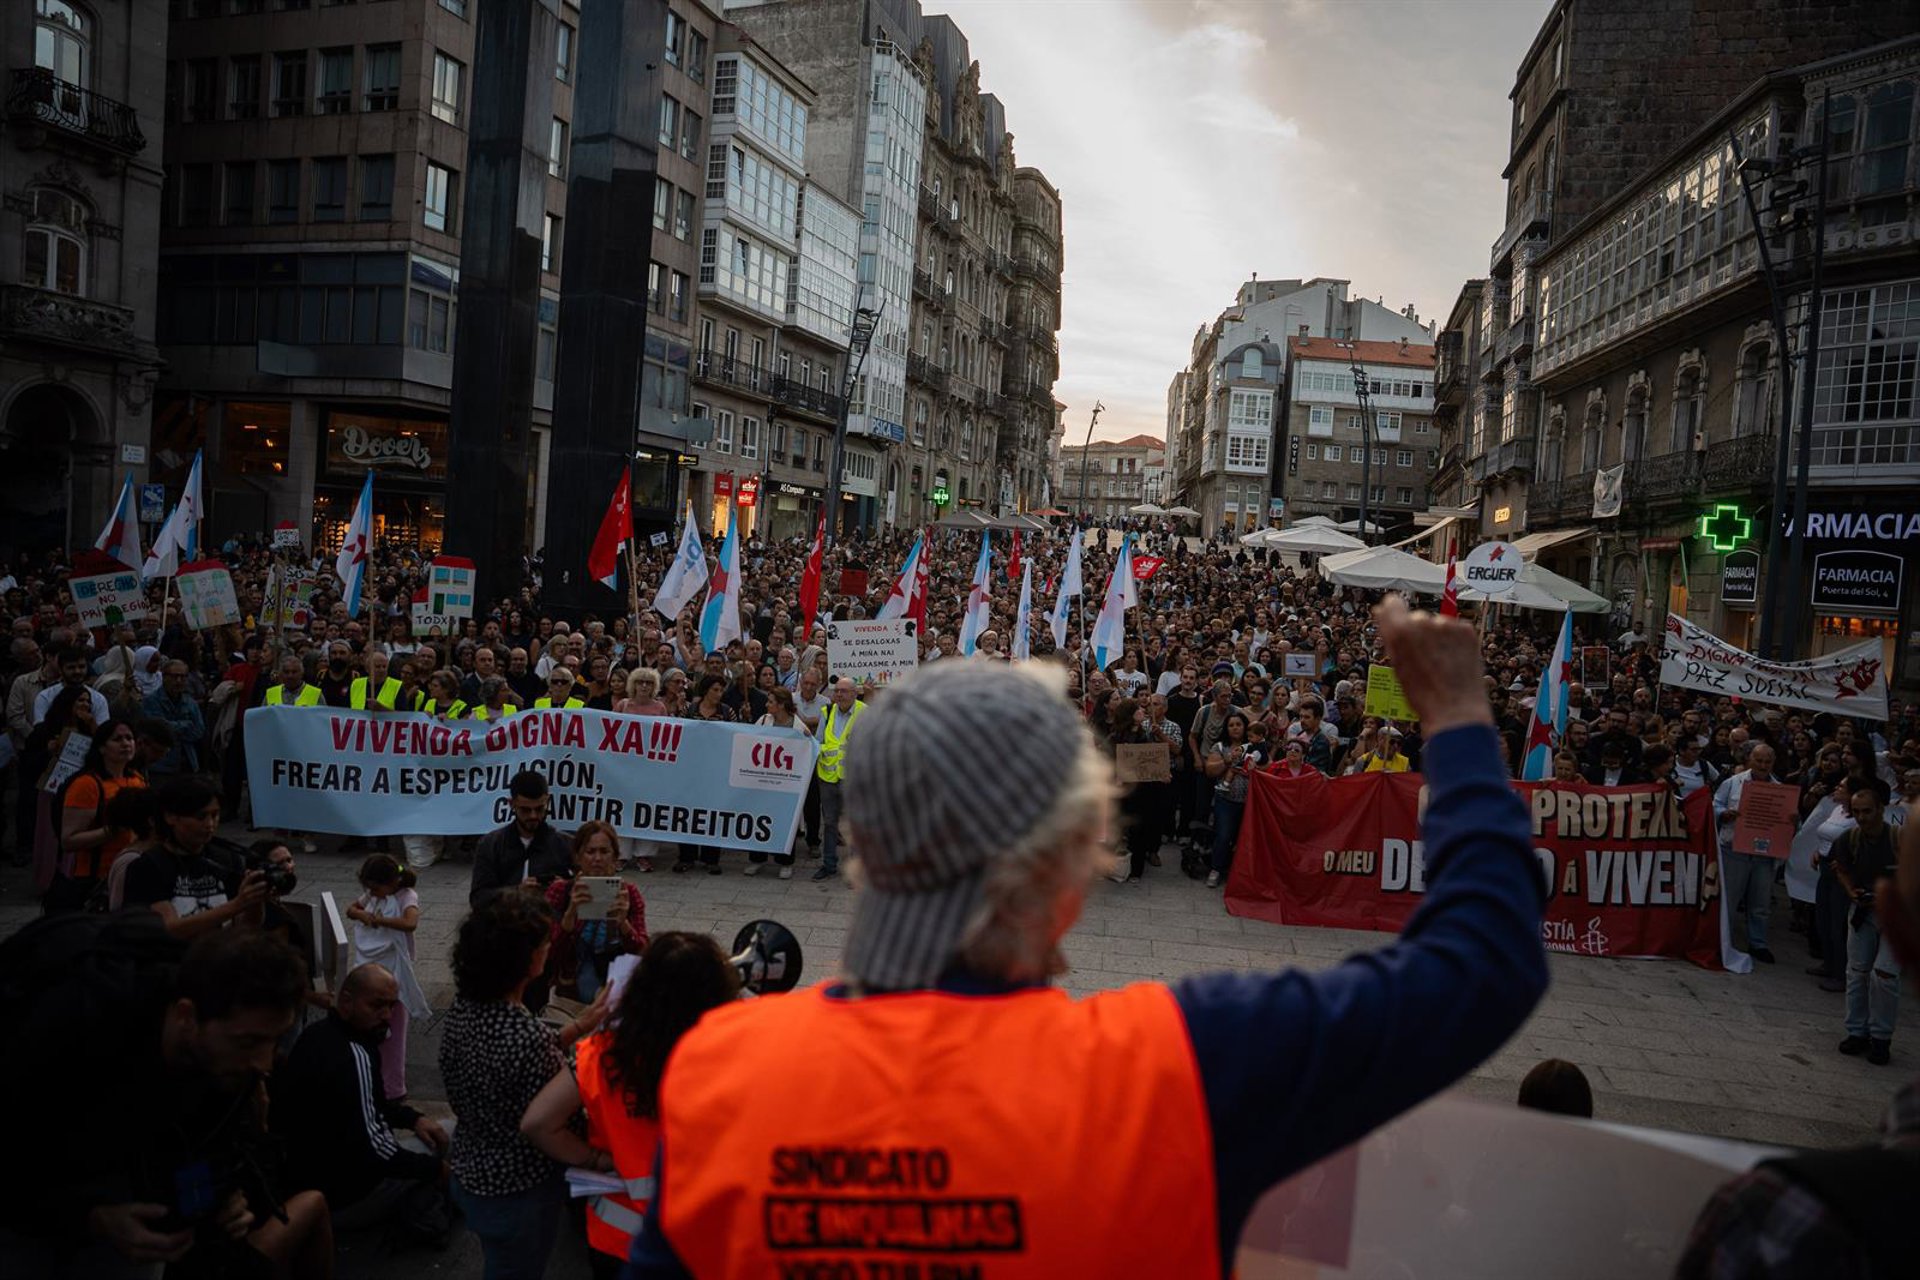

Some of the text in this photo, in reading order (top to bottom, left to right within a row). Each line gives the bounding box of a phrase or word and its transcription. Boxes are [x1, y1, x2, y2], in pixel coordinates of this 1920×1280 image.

[1781, 512, 1920, 540] RMACIA
[1467, 565, 1516, 581] ERGUER
[1725, 566, 1755, 578] FARMACIA
[1819, 567, 1895, 584] FARMACIA
[80, 575, 138, 598] DERECHO
[99, 594, 116, 605] NO
[1822, 585, 1889, 598] Puerta del Sol, 4
[854, 625, 888, 633] VIVENDA
[1686, 643, 1745, 666] DIGNA
[1681, 661, 1731, 690] PAZ
[331, 712, 683, 762] VIVENDA DIGNA XA!!!
[751, 743, 793, 770] CIG
[272, 758, 361, 792] FREAR
[371, 767, 390, 794] A
[493, 794, 772, 842] GANTIR DEREITOS
[1531, 789, 1688, 838] PROTEXE
[1323, 850, 1374, 873] O MEU
[1585, 851, 1706, 905] VIVEN
[770, 1146, 950, 1190] SINDICATO
[770, 1203, 810, 1245] DE
